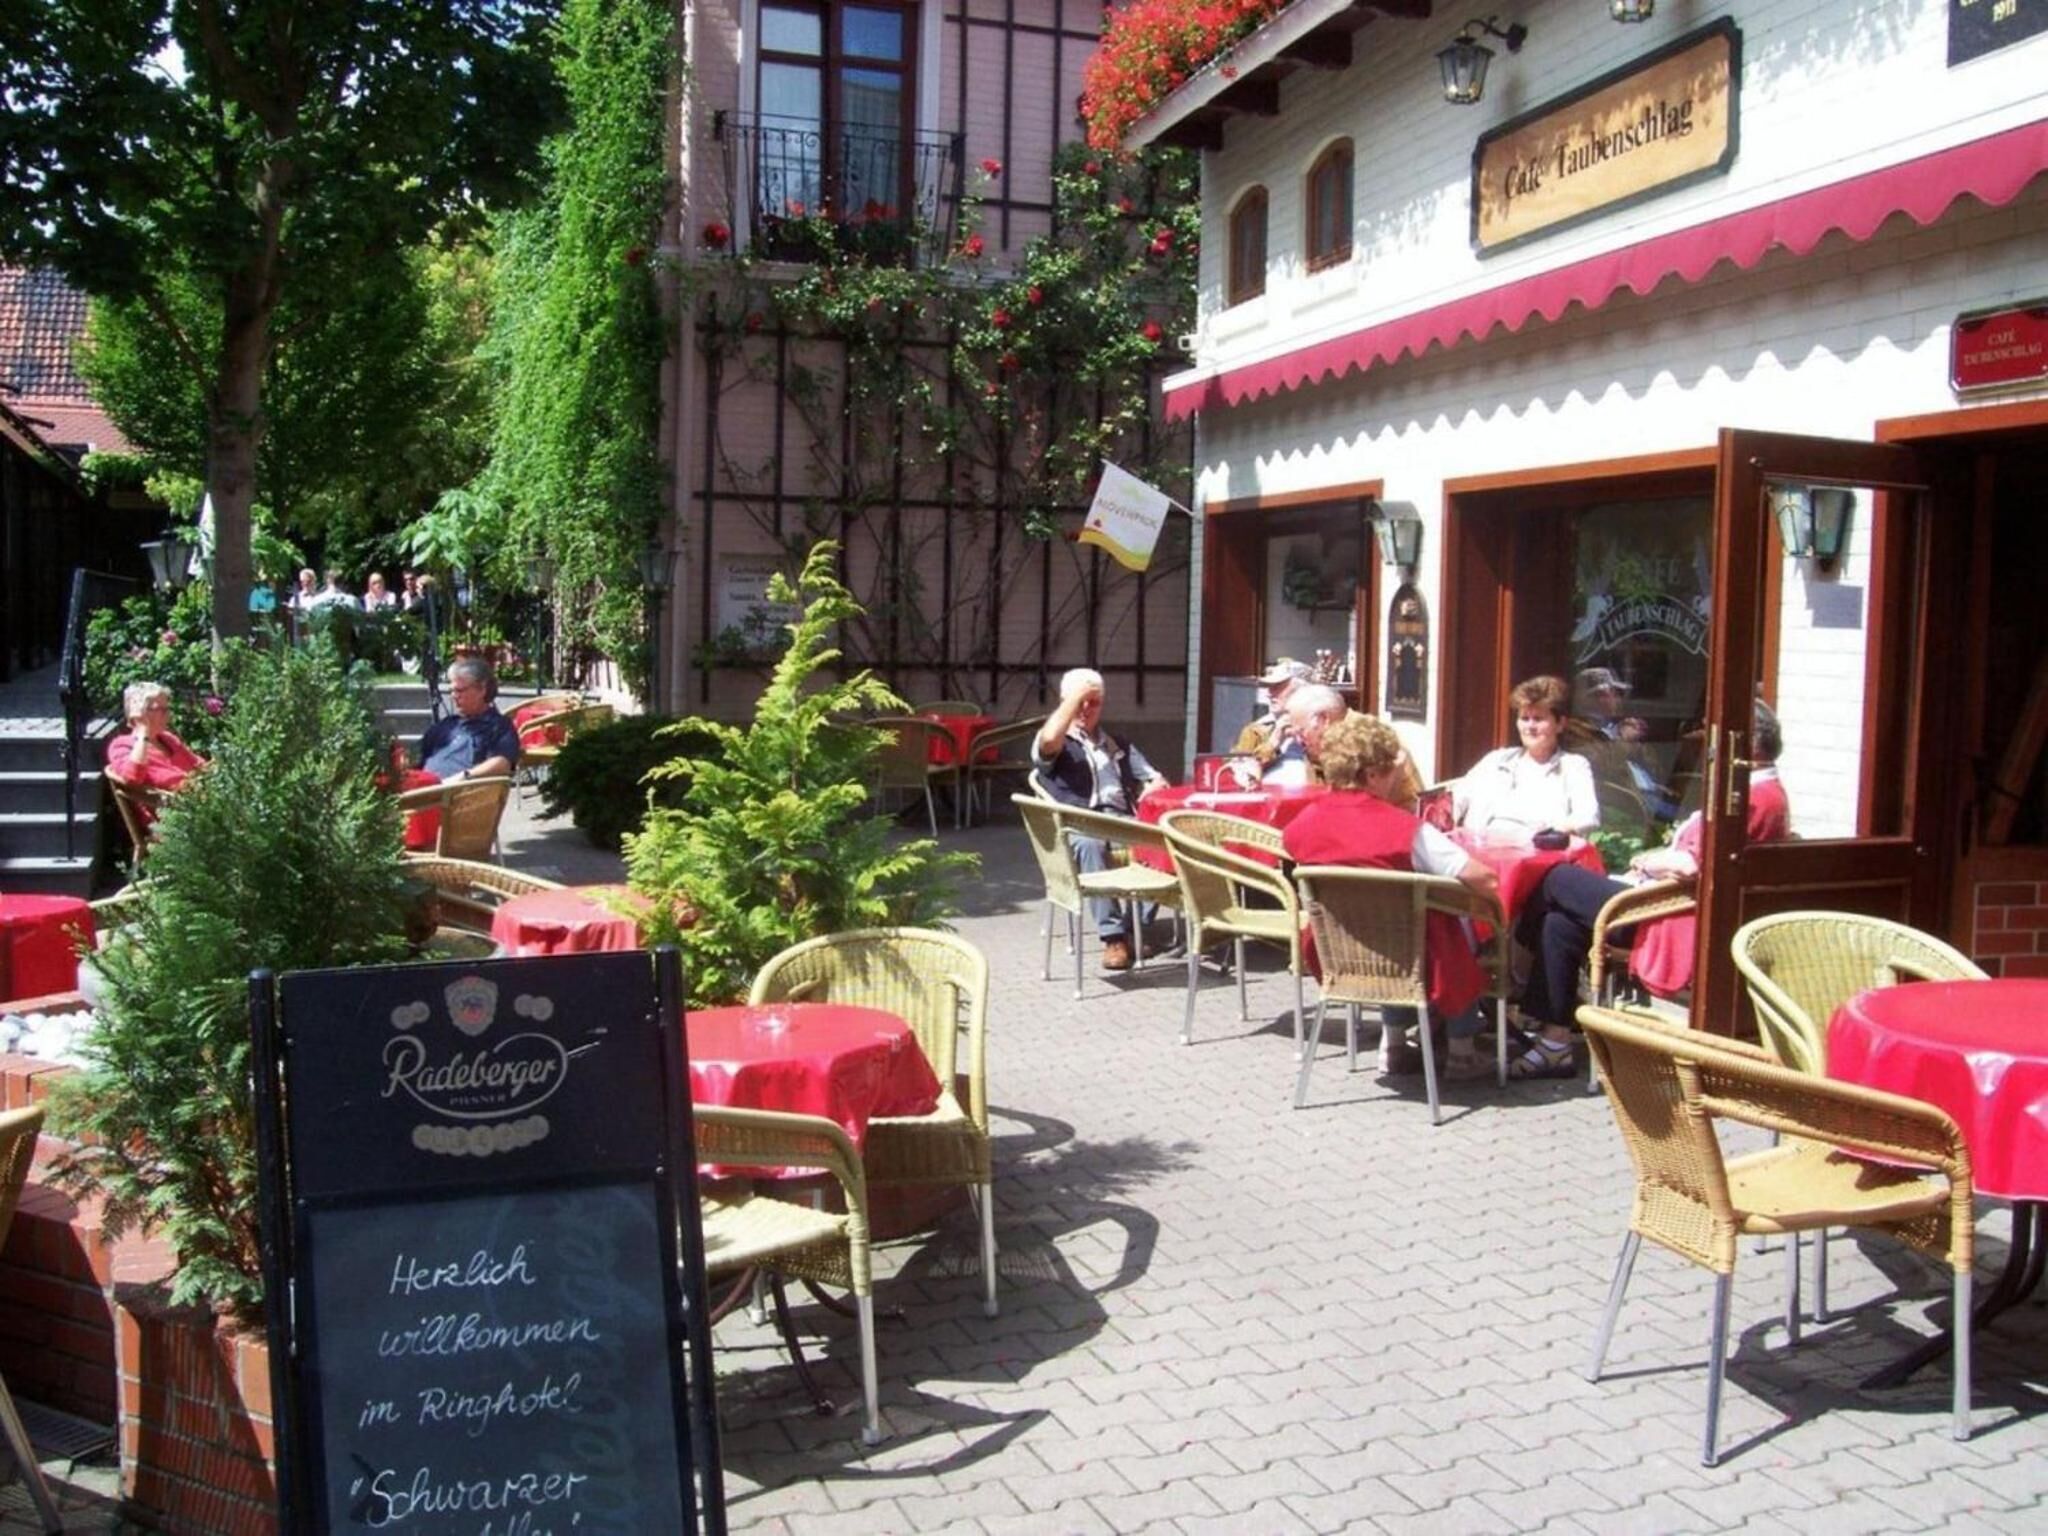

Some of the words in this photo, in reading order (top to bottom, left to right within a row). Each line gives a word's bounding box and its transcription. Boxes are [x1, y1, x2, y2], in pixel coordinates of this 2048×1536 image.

[1555, 99, 1694, 179] Taubenschlag
[381, 1034, 556, 1098] Radeberger
[388, 1244, 537, 1295] Herzlich
[378, 1313, 600, 1357] willkommen
[359, 1399, 400, 1430] im
[418, 1372, 583, 1438] Ringhotel
